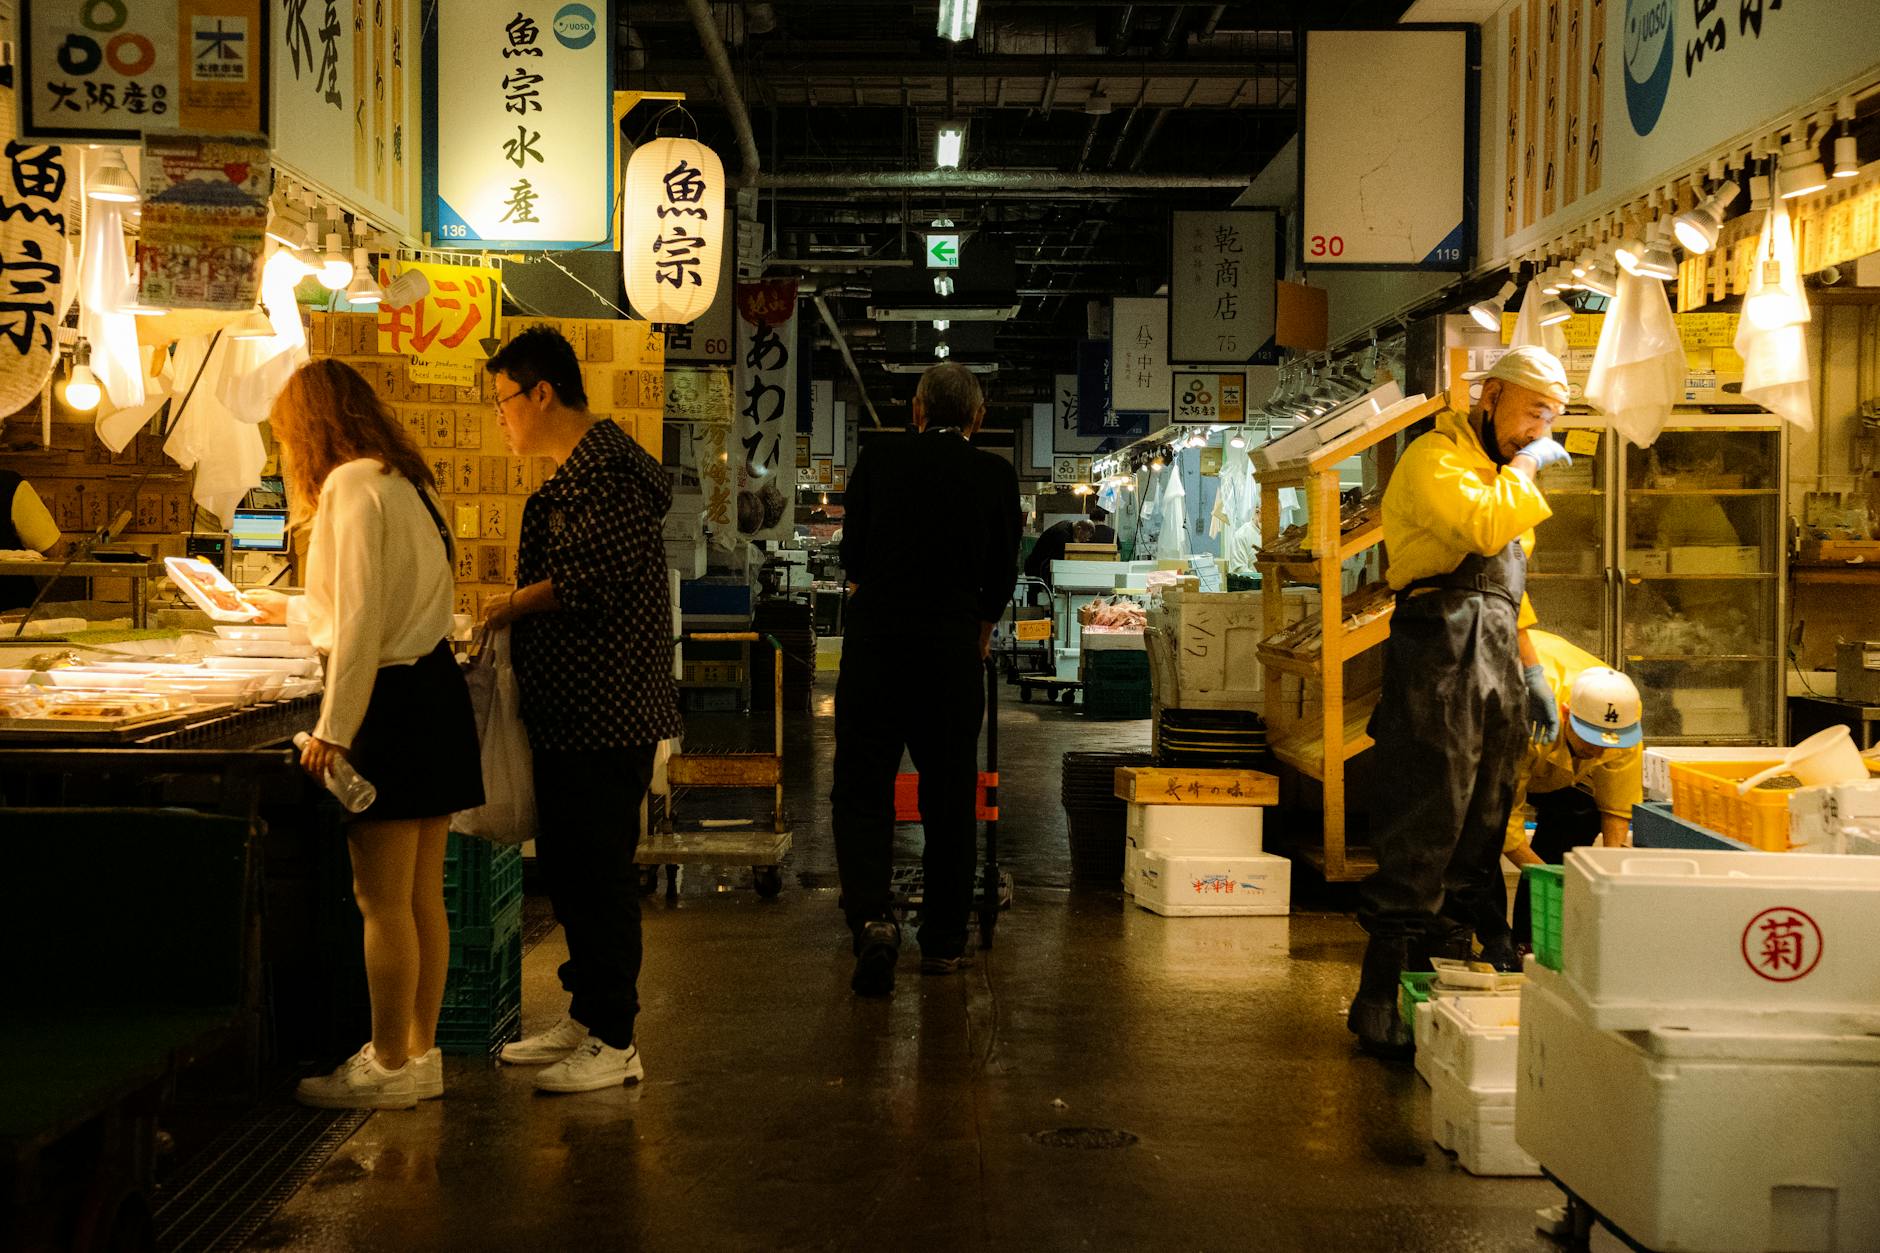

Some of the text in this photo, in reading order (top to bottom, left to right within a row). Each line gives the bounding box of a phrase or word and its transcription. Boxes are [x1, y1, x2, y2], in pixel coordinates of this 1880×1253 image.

[570, 23, 590, 31] UOSO
[498, 12, 544, 224] 魚宗水産
[442, 225, 466, 237] 136
[652, 160, 708, 288] 魚宗
[1311, 236, 1344, 257] 30
[1436, 249, 1460, 260] 119
[1214, 225, 1243, 320] 乾商店
[705, 339, 727, 353] 60
[1218, 336, 1237, 352] 75
[742, 317, 788, 478] あわび
[1604, 702, 1619, 723] LA
[1760, 916, 1803, 971] 菊
